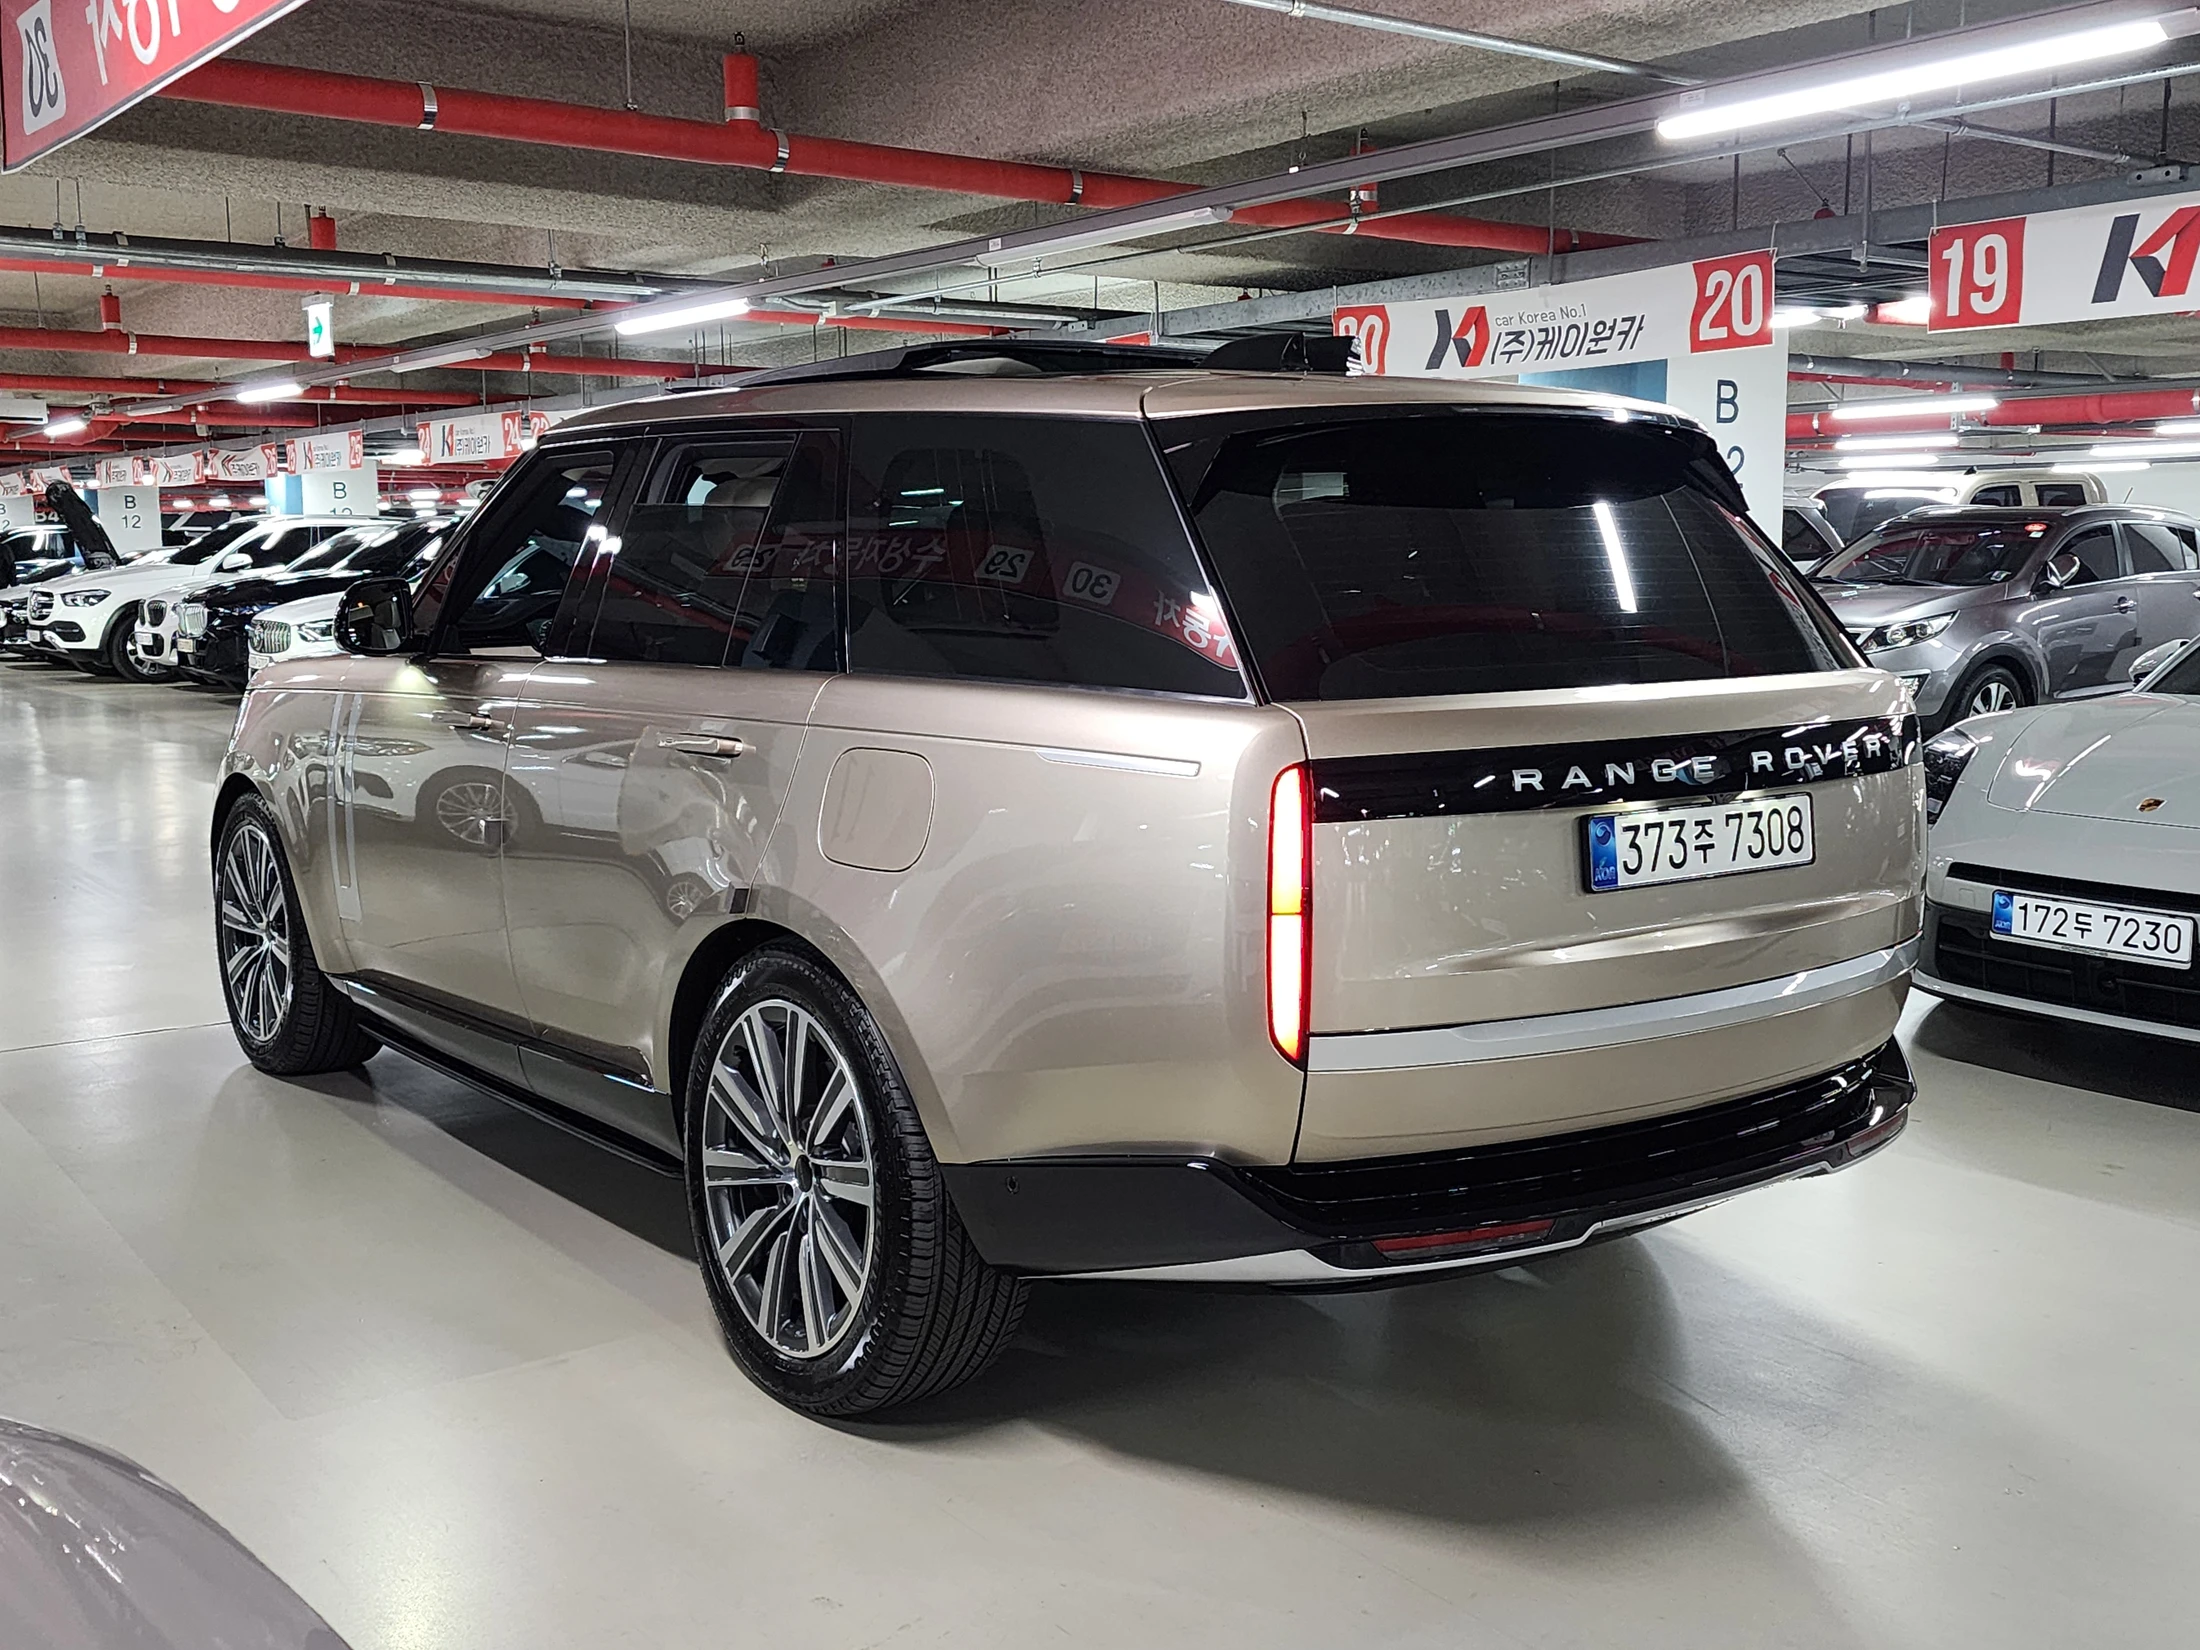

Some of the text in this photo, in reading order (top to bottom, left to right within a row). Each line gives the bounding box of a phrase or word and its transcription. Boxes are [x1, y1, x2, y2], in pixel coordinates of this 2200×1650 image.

[1942, 233, 2009, 318] 19
[1495, 303, 1587, 327] car Korea No.1
[1699, 264, 1764, 341] 20
[1491, 314, 1645, 365] (주)케이원카
[1717, 380, 1739, 423] B
[350, 434, 362, 465] 25
[504, 417, 522, 452] 24
[125, 495, 137, 509] B
[333, 482, 347, 499] B
[121, 515, 141, 529] 12
[1511, 738, 1883, 792] RANGE ROVER
[1621, 805, 1804, 875] 373주 7308
[2018, 902, 2182, 954] 172두 7230
